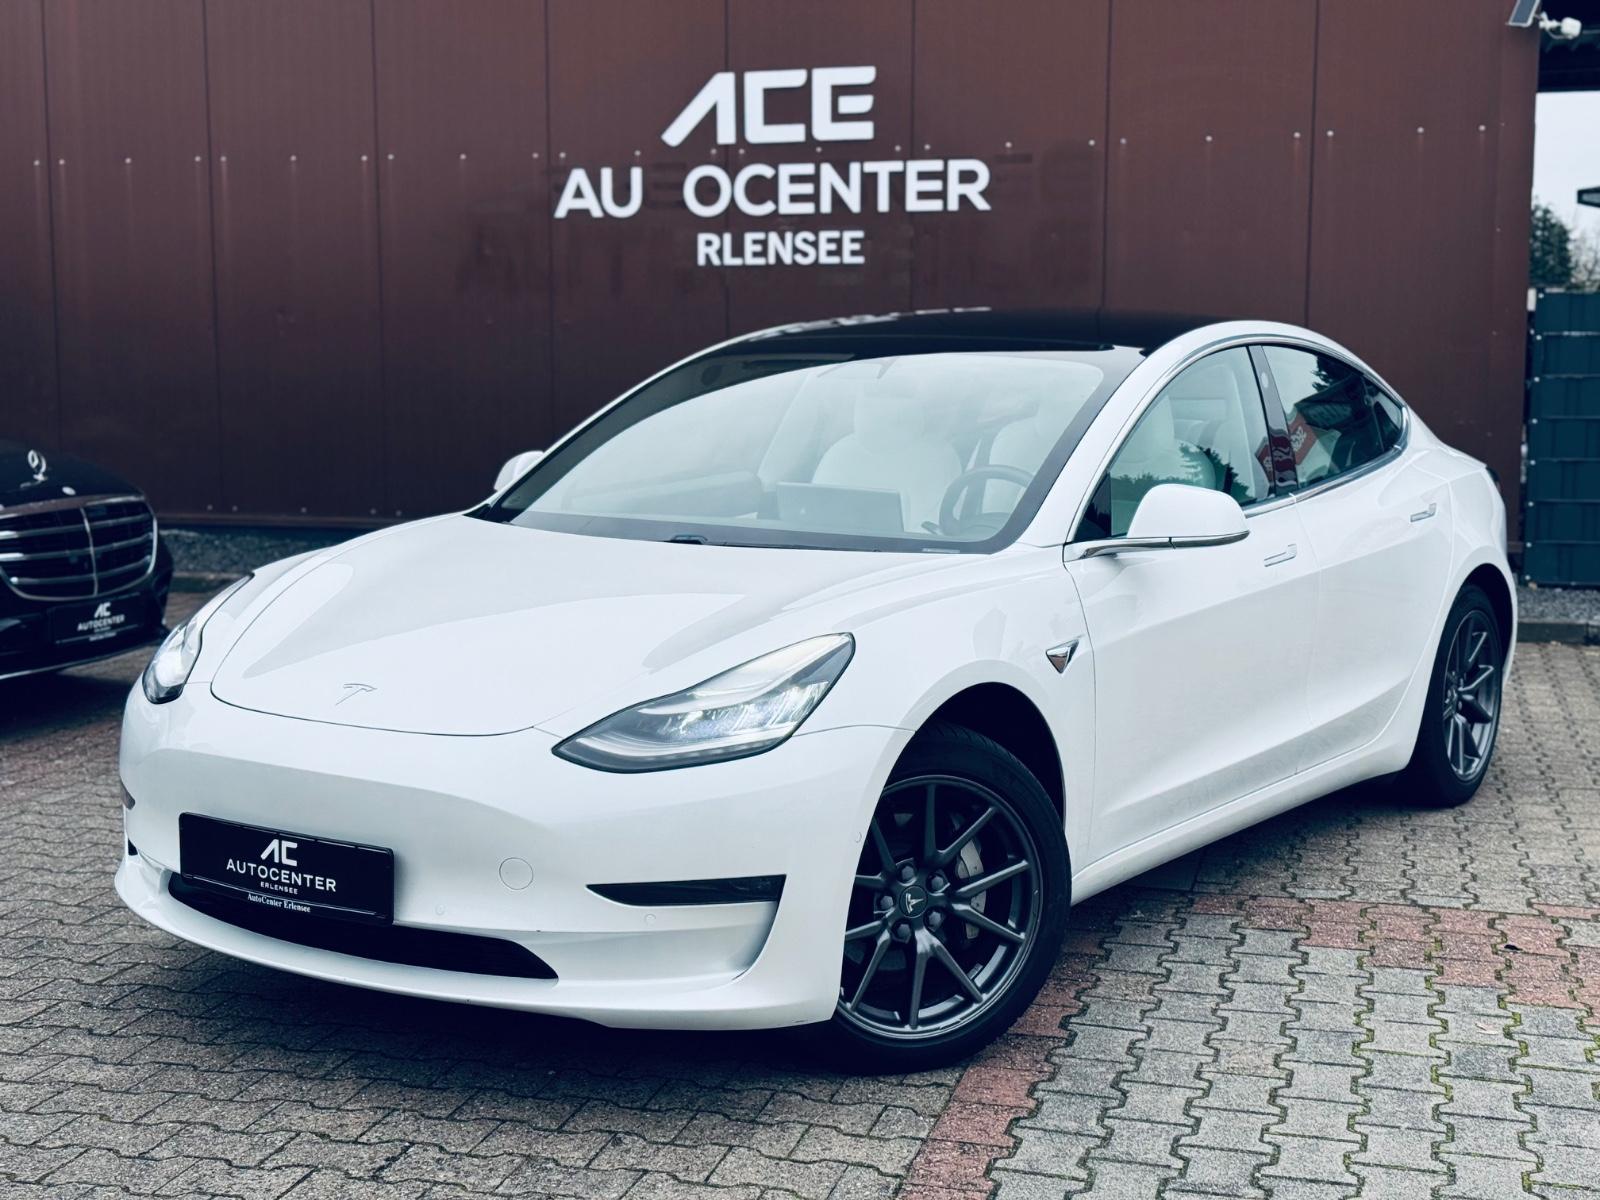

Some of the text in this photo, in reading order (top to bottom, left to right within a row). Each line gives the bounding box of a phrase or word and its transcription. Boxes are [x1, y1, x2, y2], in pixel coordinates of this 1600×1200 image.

[661, 66, 876, 147] ACE
[553, 158, 992, 219] AU OCENTER
[697, 230, 866, 266] RLENSEE
[260, 838, 298, 867] AC
[226, 858, 337, 892] AUTOCENTER
[260, 881, 298, 895] ERLENSEE
[248, 893, 311, 913] AutoCenter Erlensee
